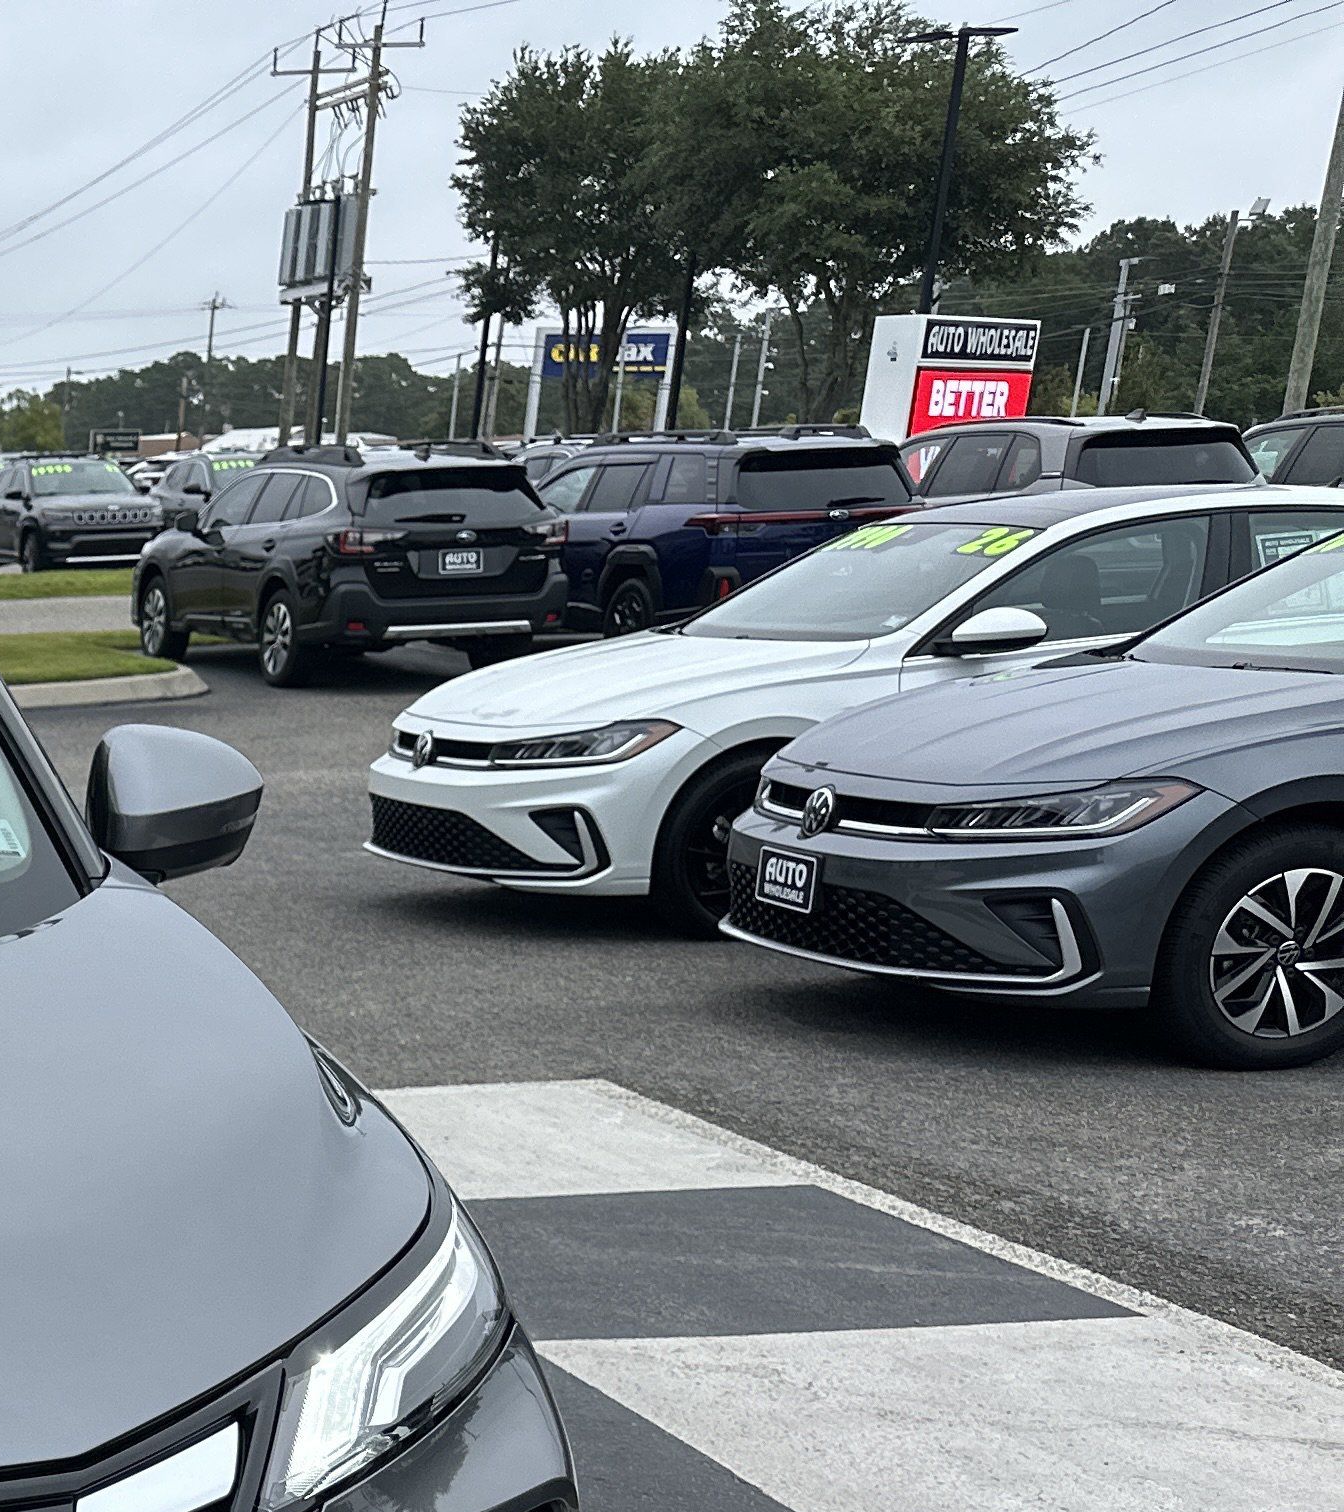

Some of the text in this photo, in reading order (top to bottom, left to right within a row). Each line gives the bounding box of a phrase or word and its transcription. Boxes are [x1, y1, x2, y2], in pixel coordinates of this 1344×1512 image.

[928, 325, 1036, 356] AUTO WHOLESALE
[928, 379, 1009, 417] BETTER
[957, 527, 1035, 556] 26
[445, 552, 478, 564] AUTO
[765, 857, 807, 888] AUTO
